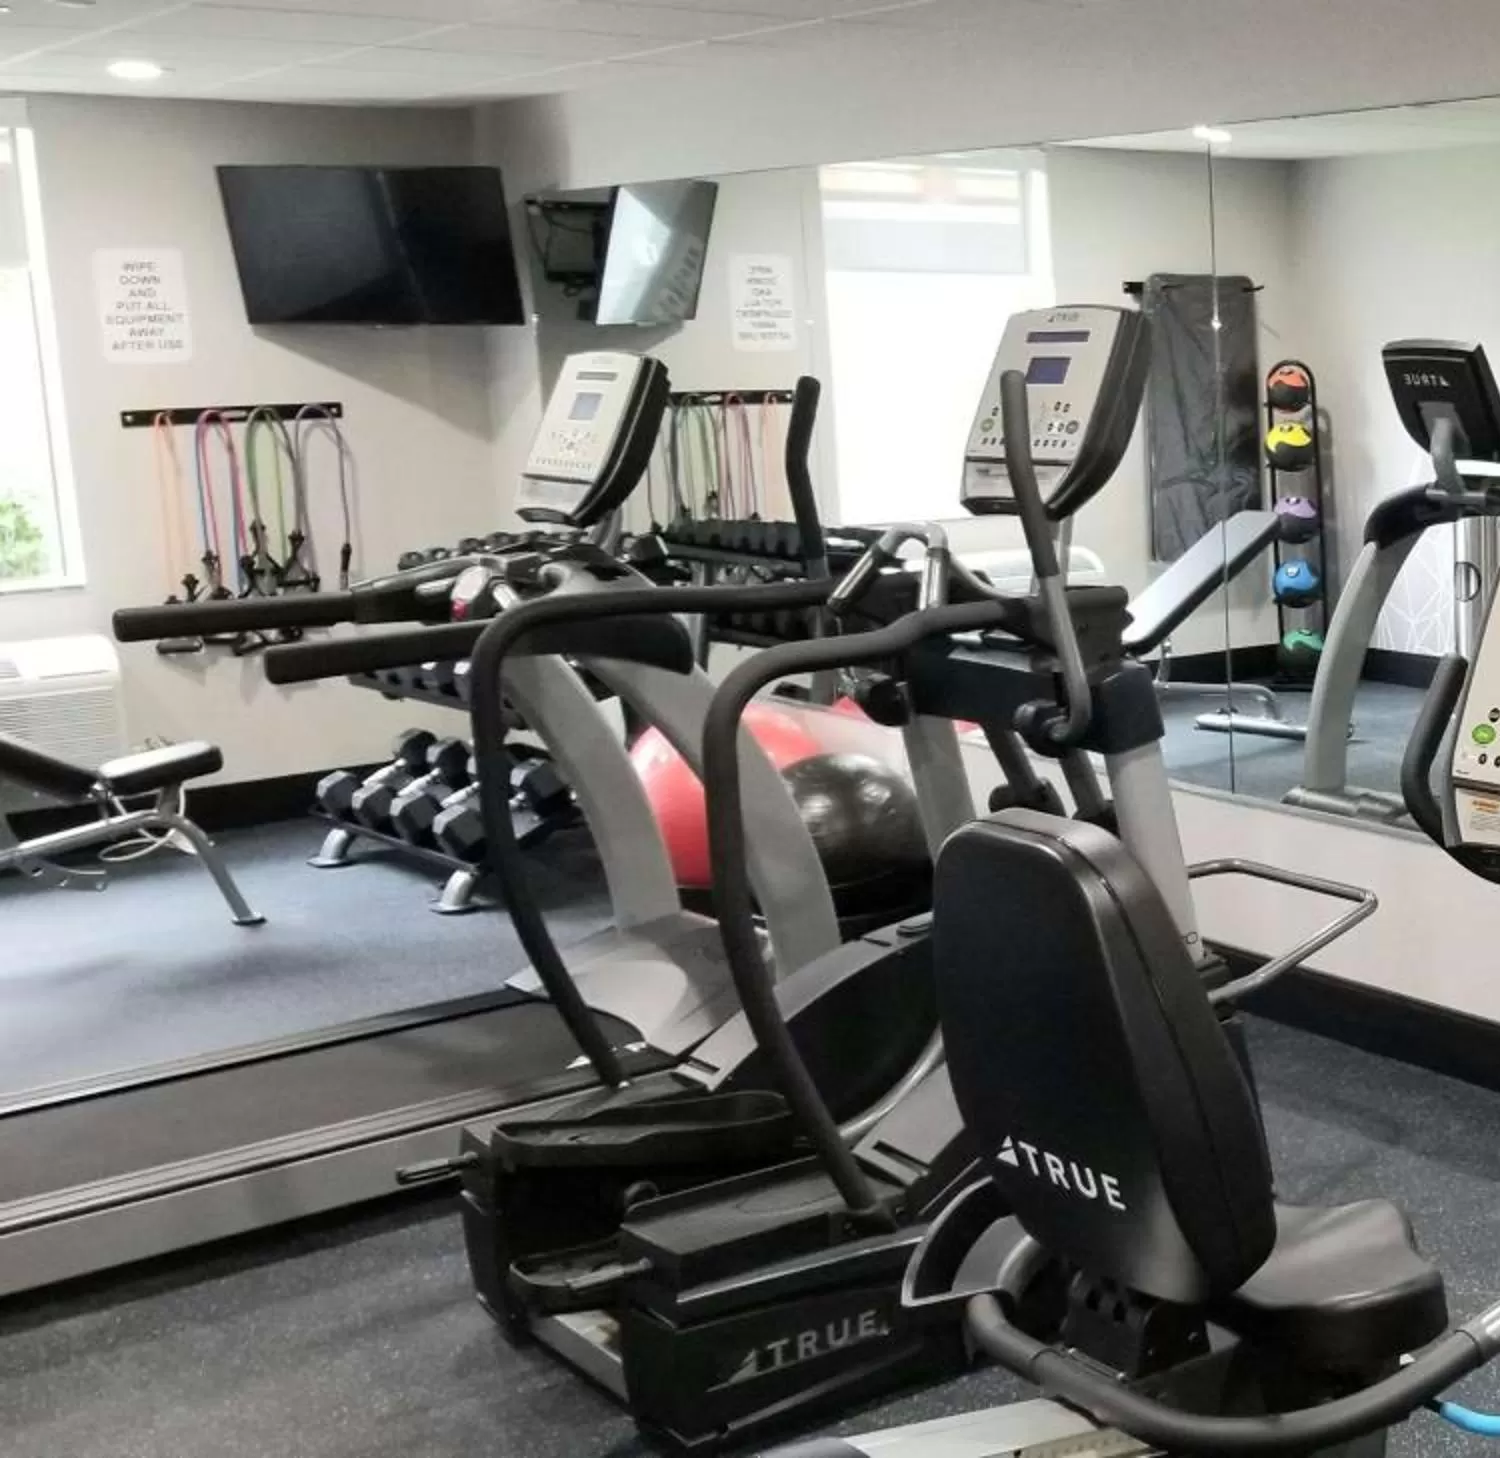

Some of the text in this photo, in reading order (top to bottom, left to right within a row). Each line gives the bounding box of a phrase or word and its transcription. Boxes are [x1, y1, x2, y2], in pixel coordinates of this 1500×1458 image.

[121, 261, 158, 273] WIPE
[118, 275, 161, 286] DOWN
[128, 286, 157, 298] AND
[115, 300, 172, 313] PUT ALL
[105, 312, 185, 326] EQUIPMENT
[128, 326, 165, 338] AWAY
[111, 338, 185, 351] AFTER USE
[1017, 1139, 1128, 1212] TRUE
[766, 1309, 878, 1362] TRUE
